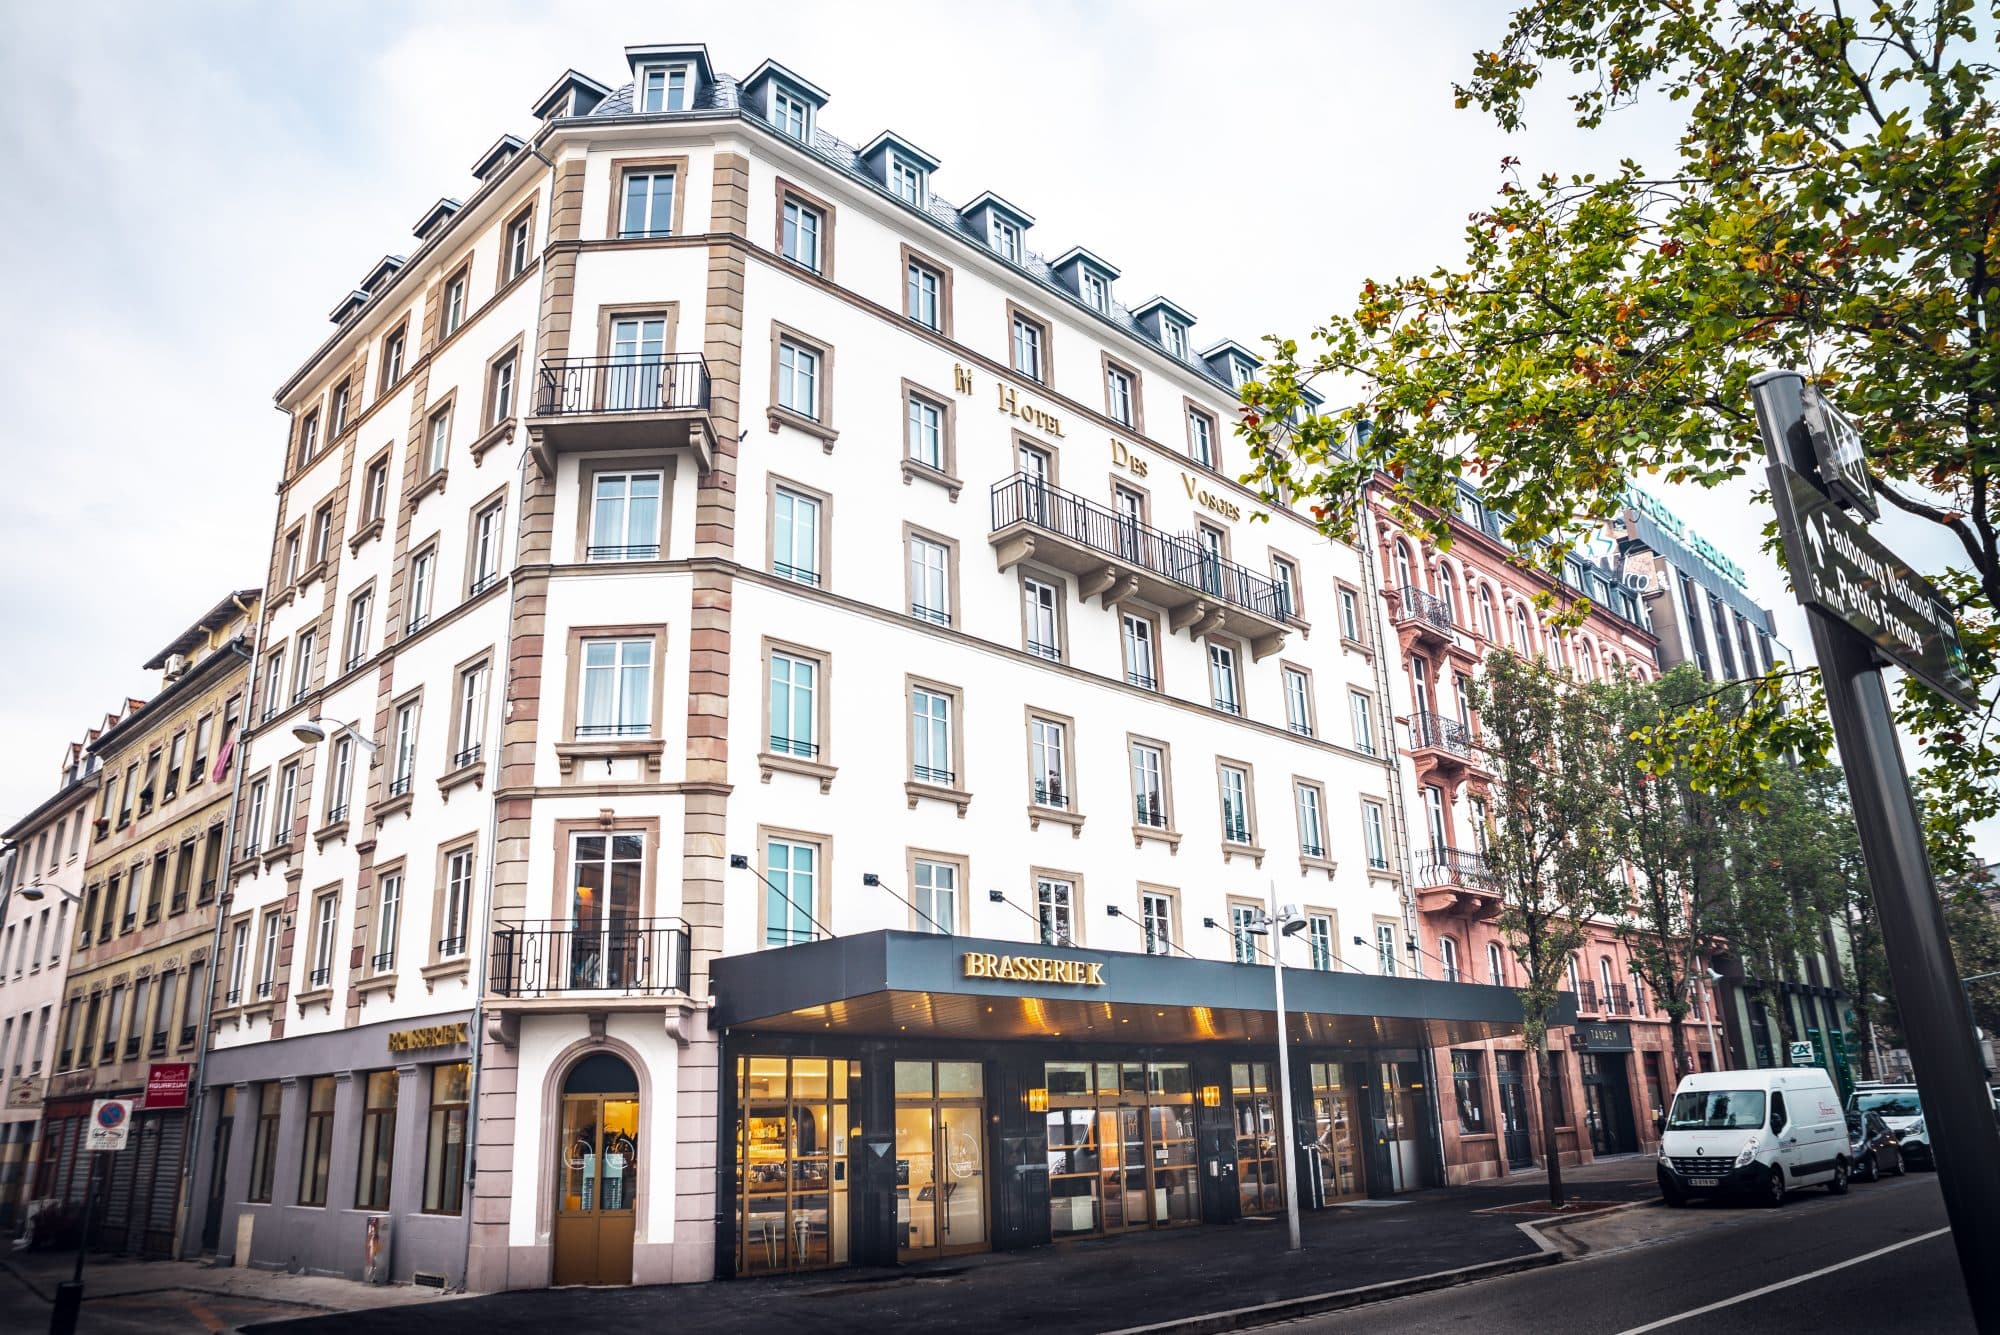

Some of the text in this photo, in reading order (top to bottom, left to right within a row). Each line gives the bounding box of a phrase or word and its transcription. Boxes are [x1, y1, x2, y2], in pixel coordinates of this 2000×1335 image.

[1110, 438, 1149, 477] DES
[1822, 511, 1936, 626] Faubourg National
[1812, 573, 1845, 613] 3 min
[1836, 565, 1923, 656] Petite France
[963, 952, 1106, 985] BRASSERIE K
